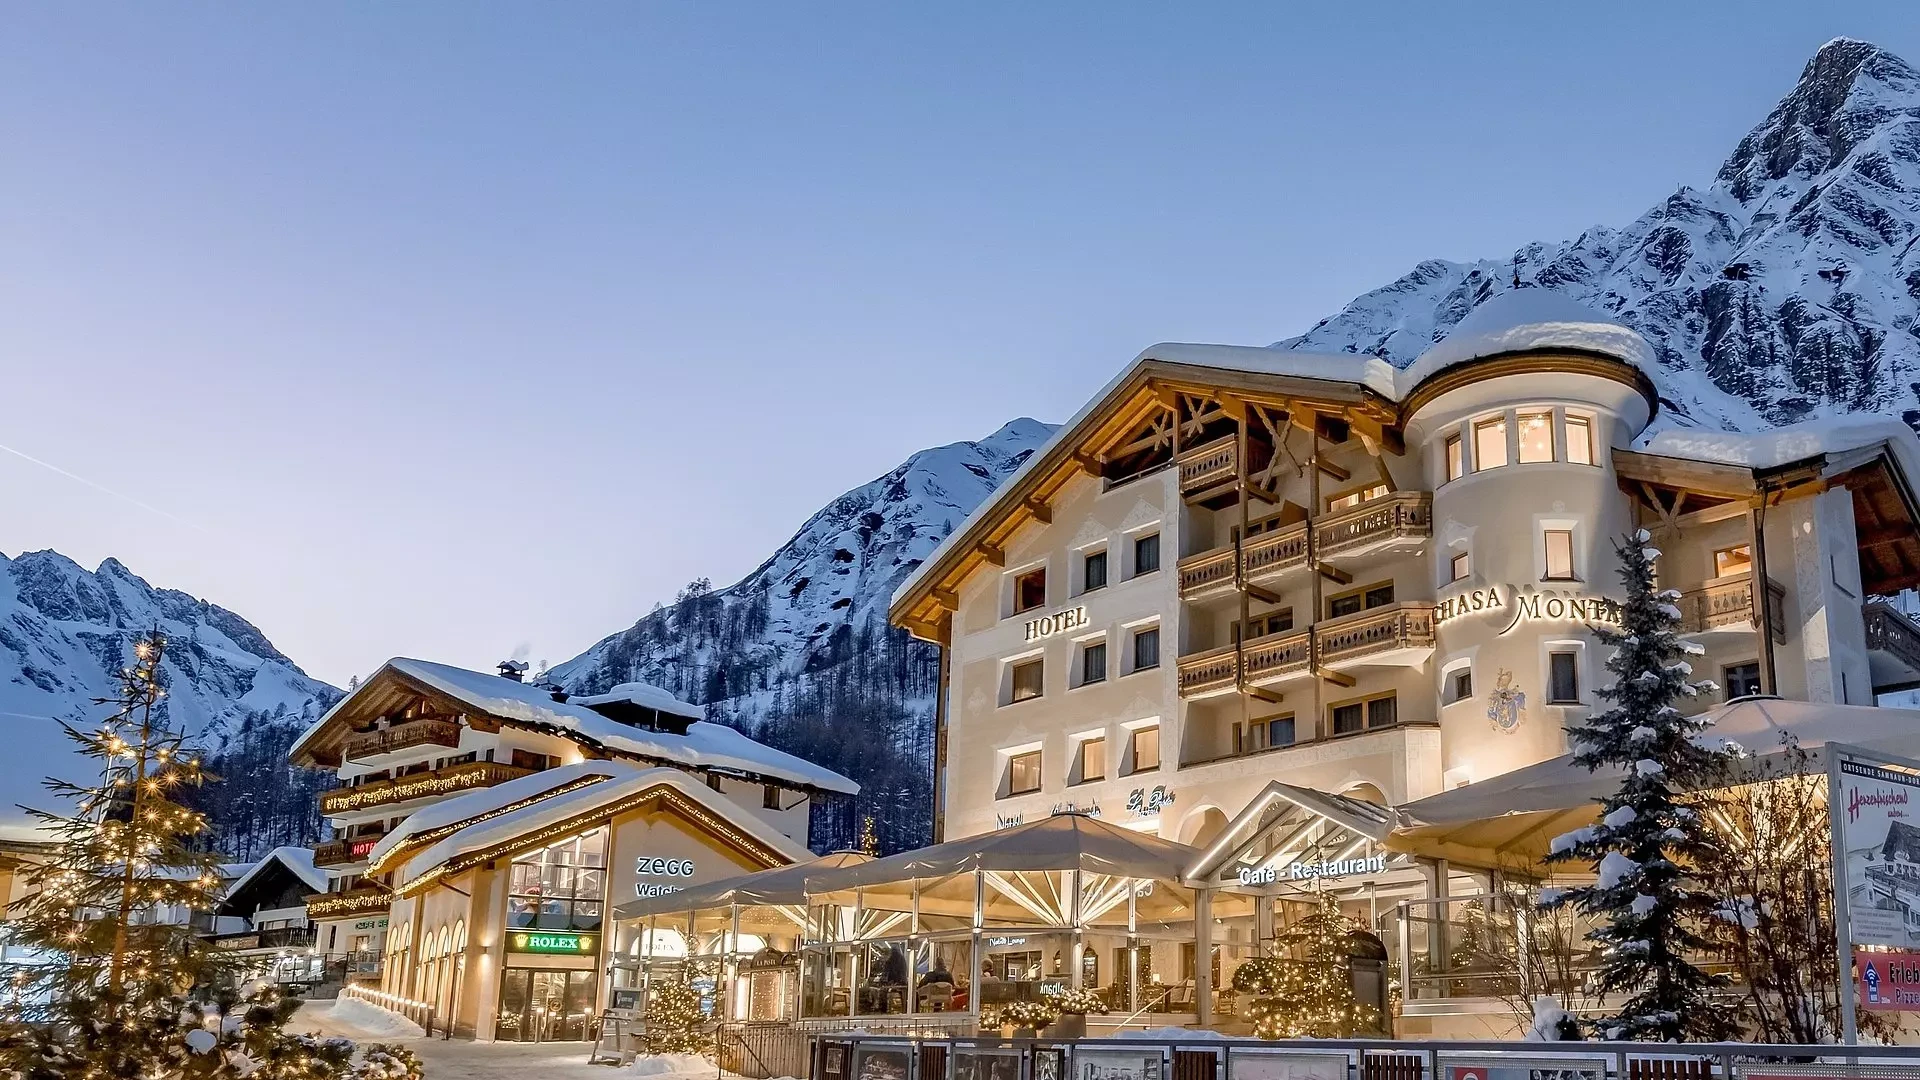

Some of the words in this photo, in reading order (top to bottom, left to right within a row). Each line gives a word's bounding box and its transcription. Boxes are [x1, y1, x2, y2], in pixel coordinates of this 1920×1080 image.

[1432, 588, 1502, 624] CHASA
[1498, 594, 1623, 635] MONTA
[1025, 606, 1089, 642] HOTEL
[1843, 763, 1875, 776] ORTSENDE
[353, 842, 376, 855] HOTE
[1239, 865, 1276, 885] Café
[1291, 854, 1385, 880] Restaurant
[529, 936, 577, 948] ROLEX
